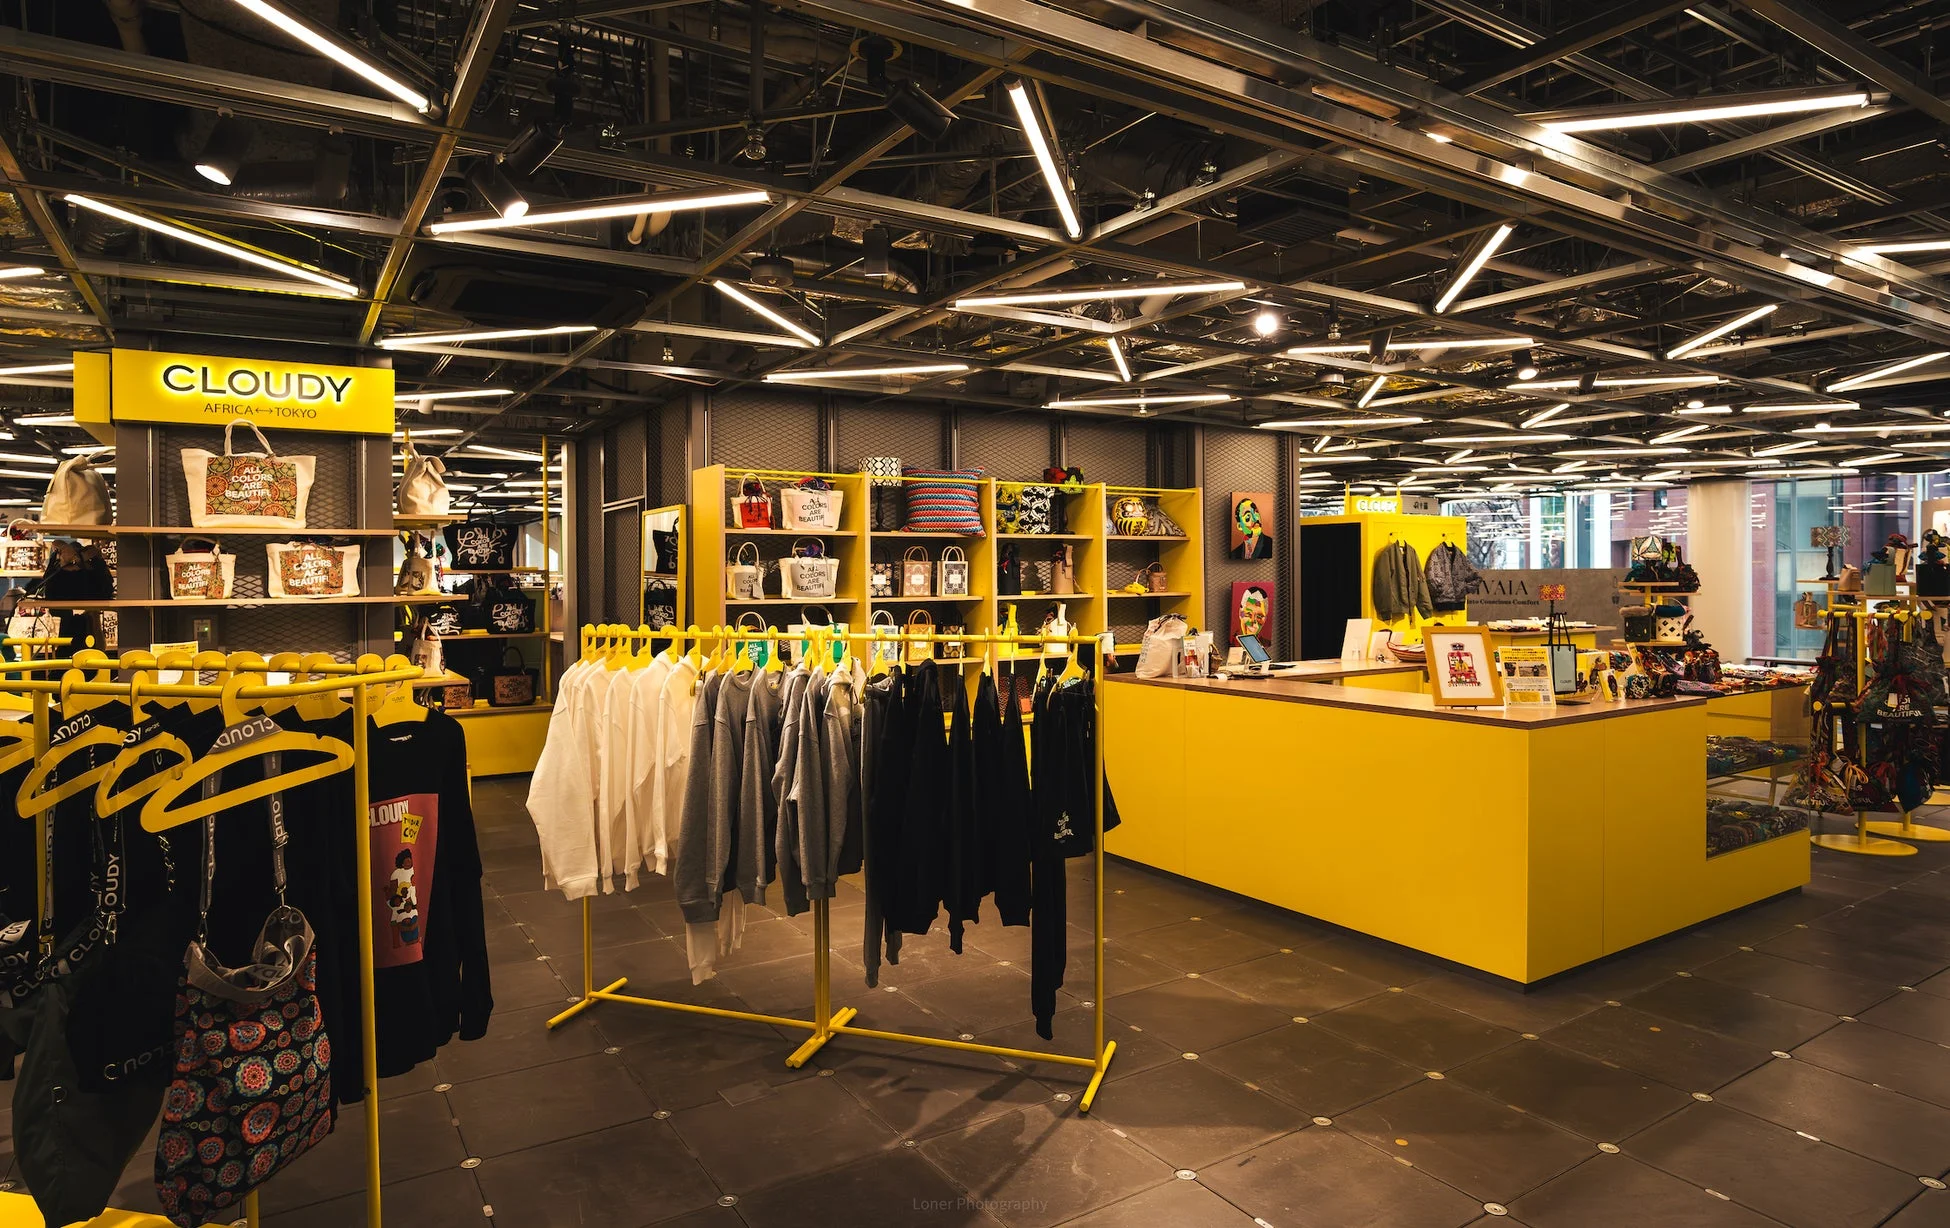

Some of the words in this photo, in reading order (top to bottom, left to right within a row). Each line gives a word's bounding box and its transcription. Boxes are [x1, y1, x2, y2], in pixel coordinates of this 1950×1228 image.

[163, 365, 352, 402] CLOUDY
[204, 403, 253, 415] AFRICA
[274, 407, 317, 418] TOKYO
[243, 466, 262, 474] ALL
[231, 474, 273, 482] COLORS
[242, 482, 263, 490] ARE
[304, 553, 322, 561] ALL
[293, 560, 331, 571] COLORS
[368, 800, 409, 827] LOUDY
